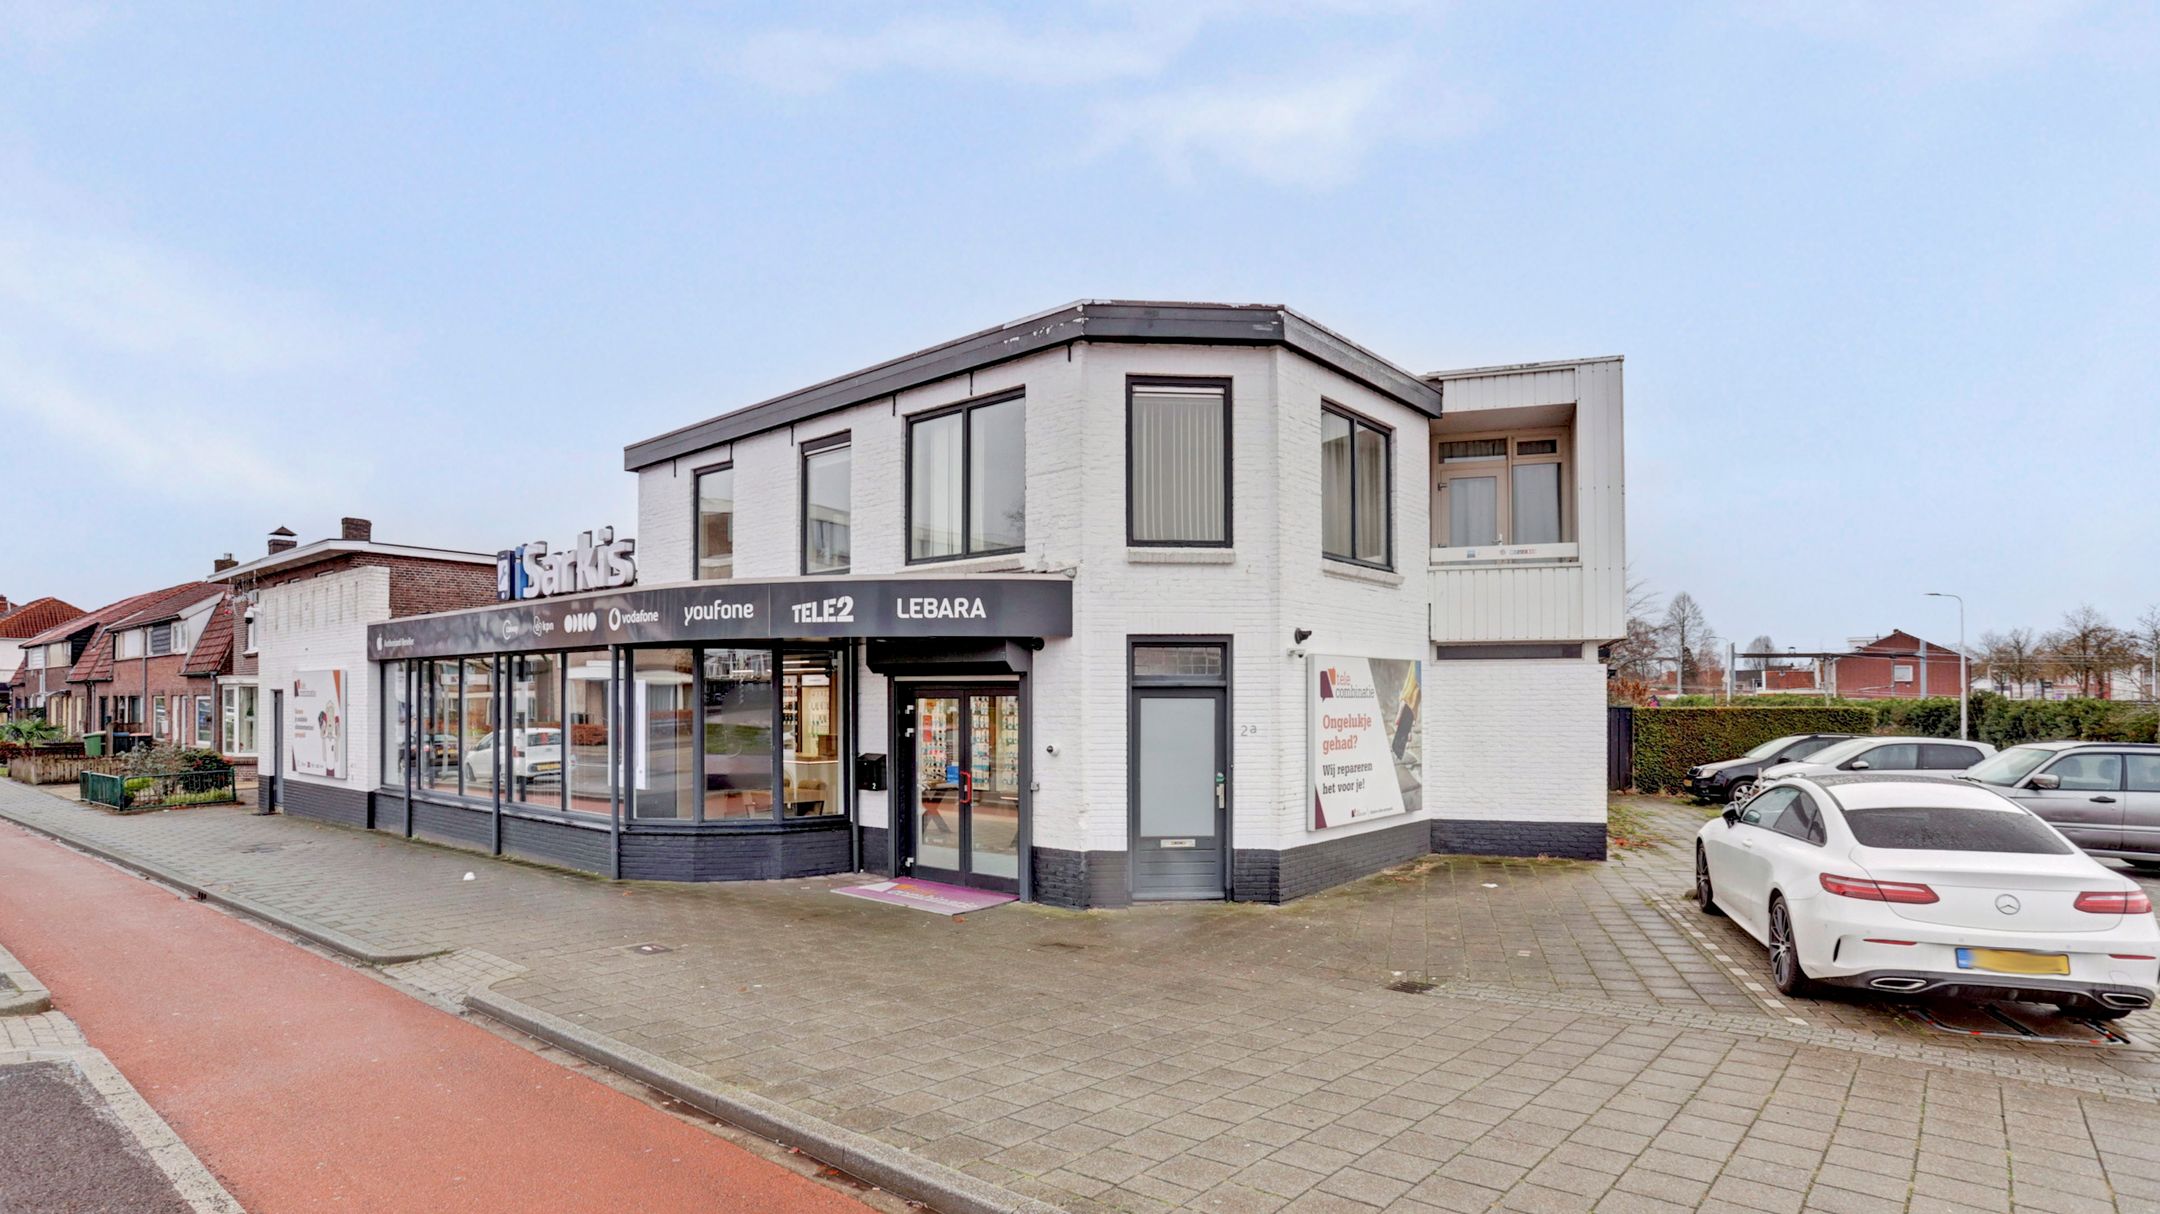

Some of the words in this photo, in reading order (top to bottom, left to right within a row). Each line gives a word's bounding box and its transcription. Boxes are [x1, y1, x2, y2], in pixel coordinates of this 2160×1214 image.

[622, 609, 659, 624] vodafone
[684, 600, 753, 626] youfone
[792, 595, 854, 623] TELE2
[897, 598, 986, 619] LEBARA
[1335, 685, 1375, 698] combinatie
[1323, 714, 1371, 732] Ongelukje
[1323, 736, 1358, 755] gehad?
[1322, 764, 1336, 777] Wij
[1337, 763, 1373, 777] repareren
[1322, 783, 1336, 795] het
[1337, 783, 1354, 793] voor
[1355, 779, 1365, 790] je!
